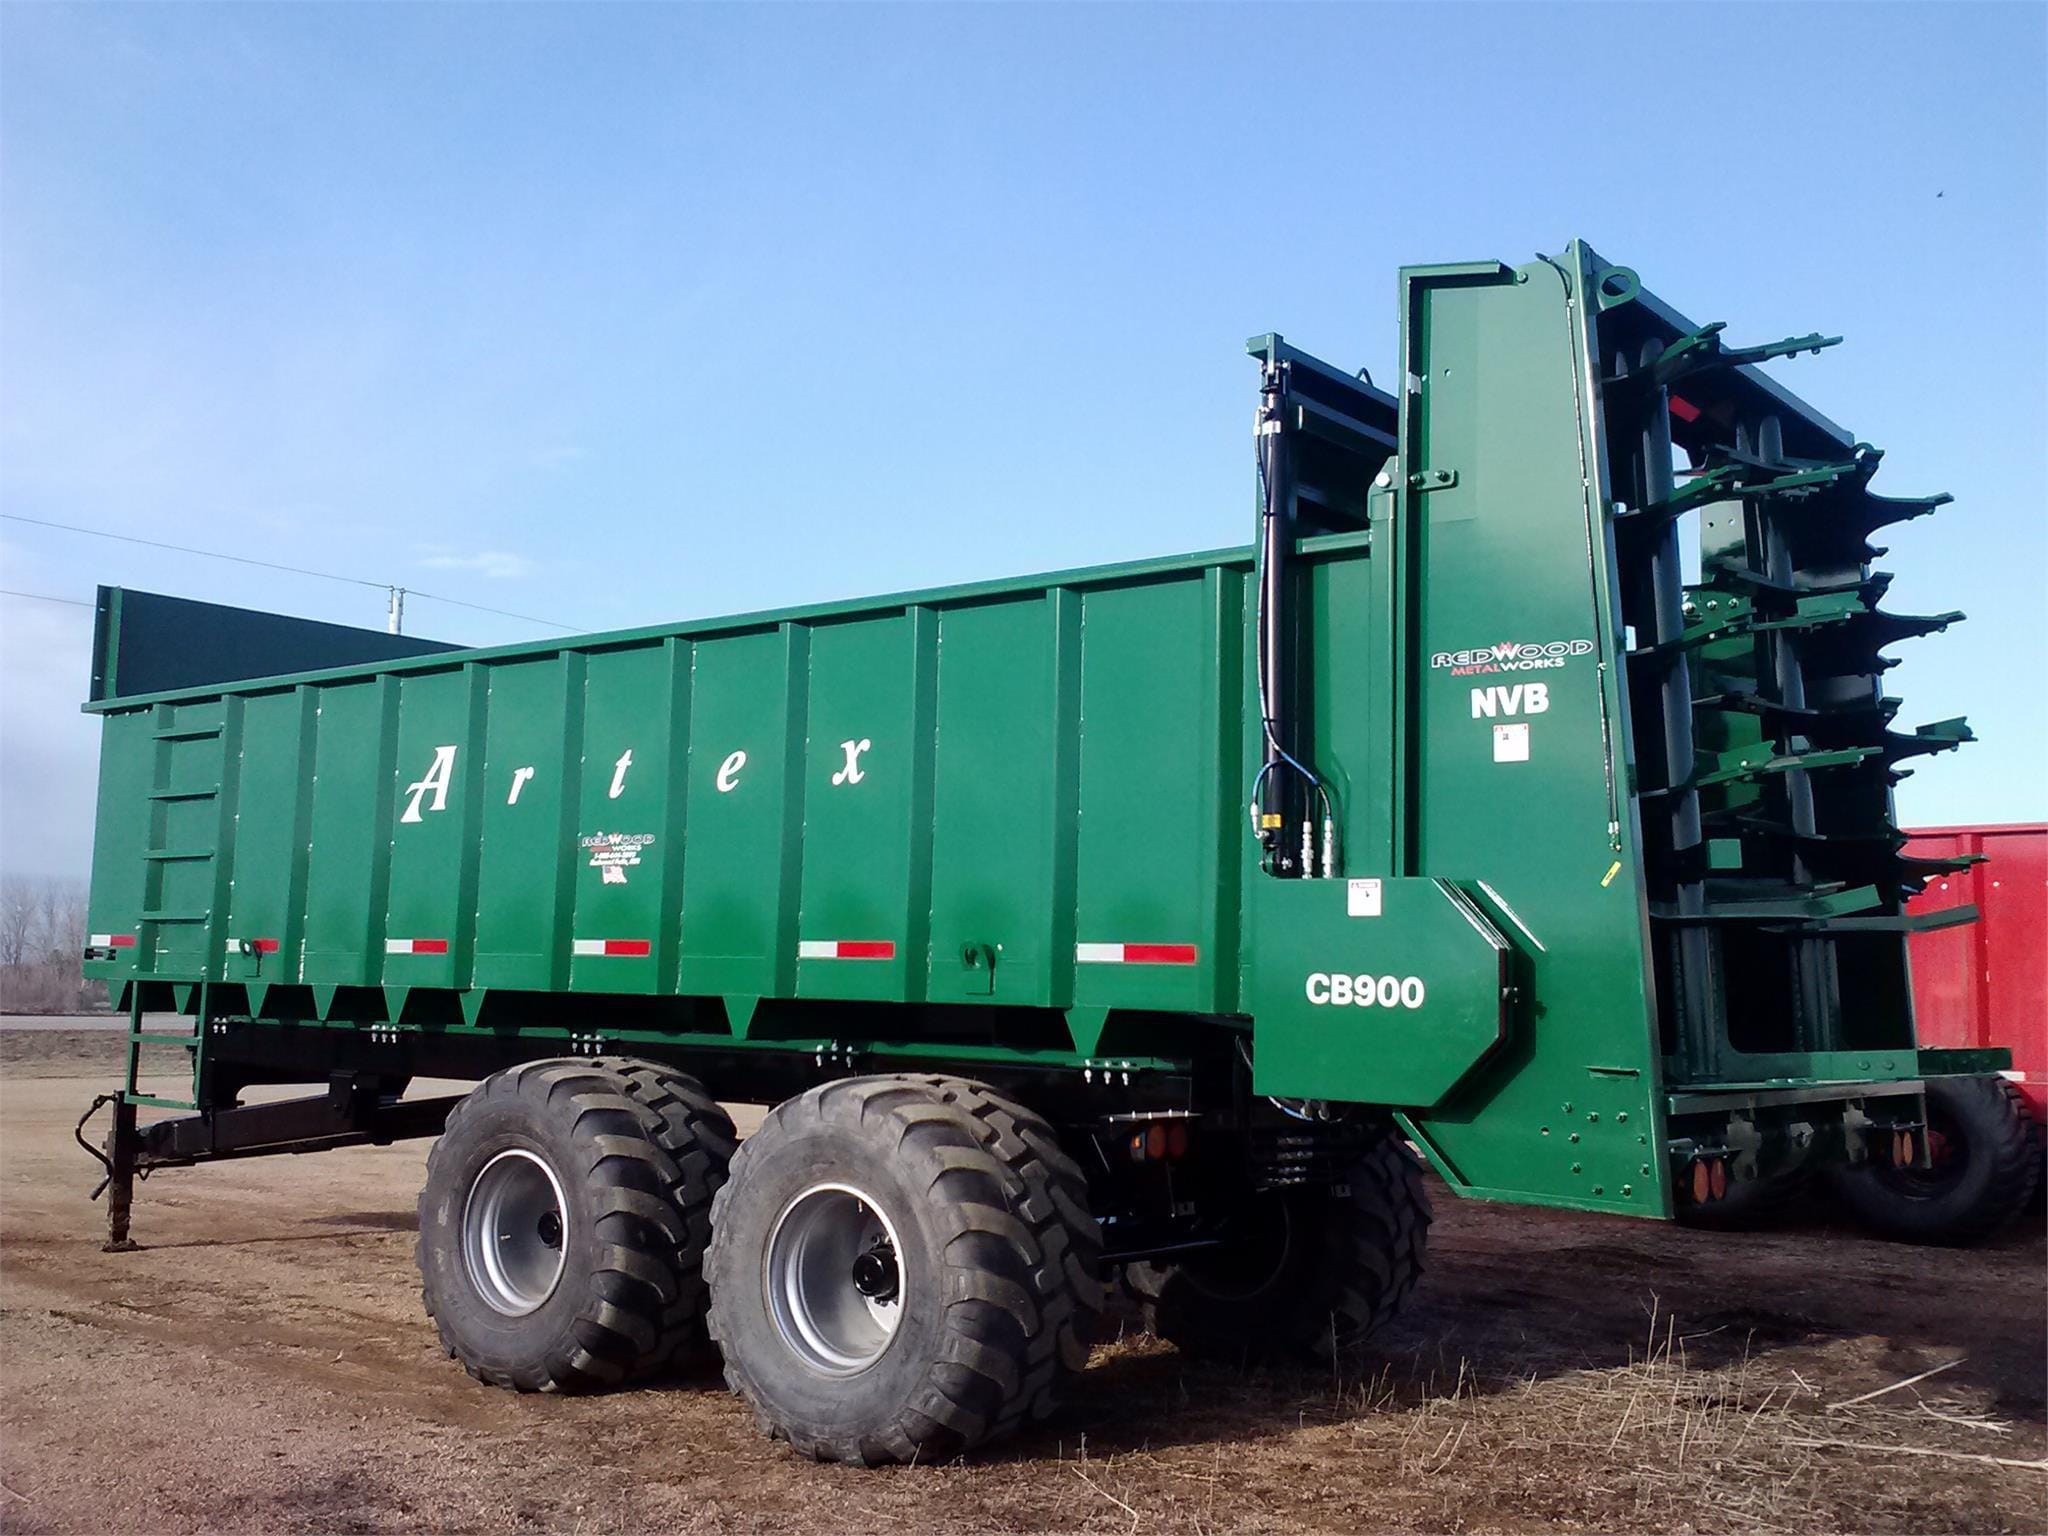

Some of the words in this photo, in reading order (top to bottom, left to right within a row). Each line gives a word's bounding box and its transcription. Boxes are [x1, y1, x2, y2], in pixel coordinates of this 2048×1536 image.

[1432, 640, 1593, 668] REDWOOD
[1471, 683, 1549, 719] NVB
[1306, 973, 1425, 1009] CB900
